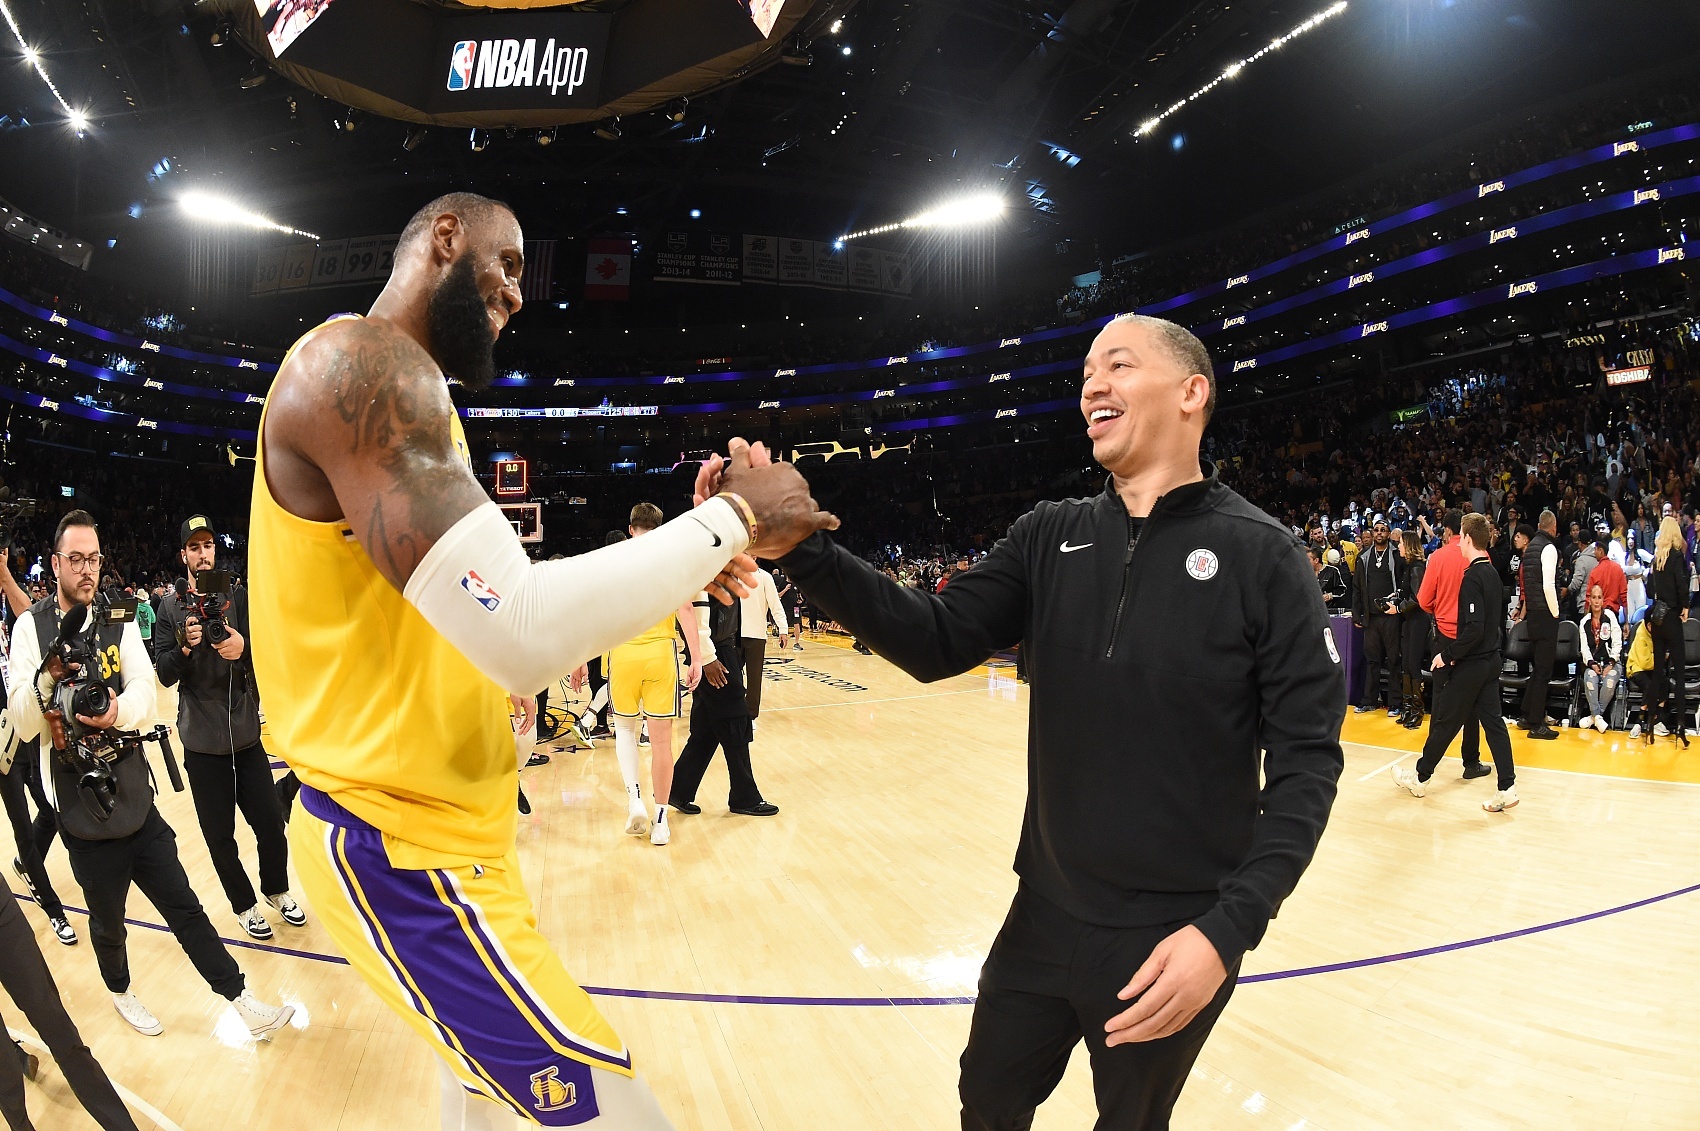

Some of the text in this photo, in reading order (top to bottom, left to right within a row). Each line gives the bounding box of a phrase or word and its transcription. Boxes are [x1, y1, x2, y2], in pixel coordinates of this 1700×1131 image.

[474, 38, 588, 95] NBA App
[317, 256, 337, 277] 18
[348, 252, 374, 274] 99
[656, 258, 696, 267] CHAMPIONS
[700, 261, 739, 270] CHAMPIONS
[661, 266, 691, 276] 2013-14
[705, 270, 733, 279] 2011-12
[1607, 368, 1652, 385] TOSHIBA
[506, 463, 518, 472] 0.0
